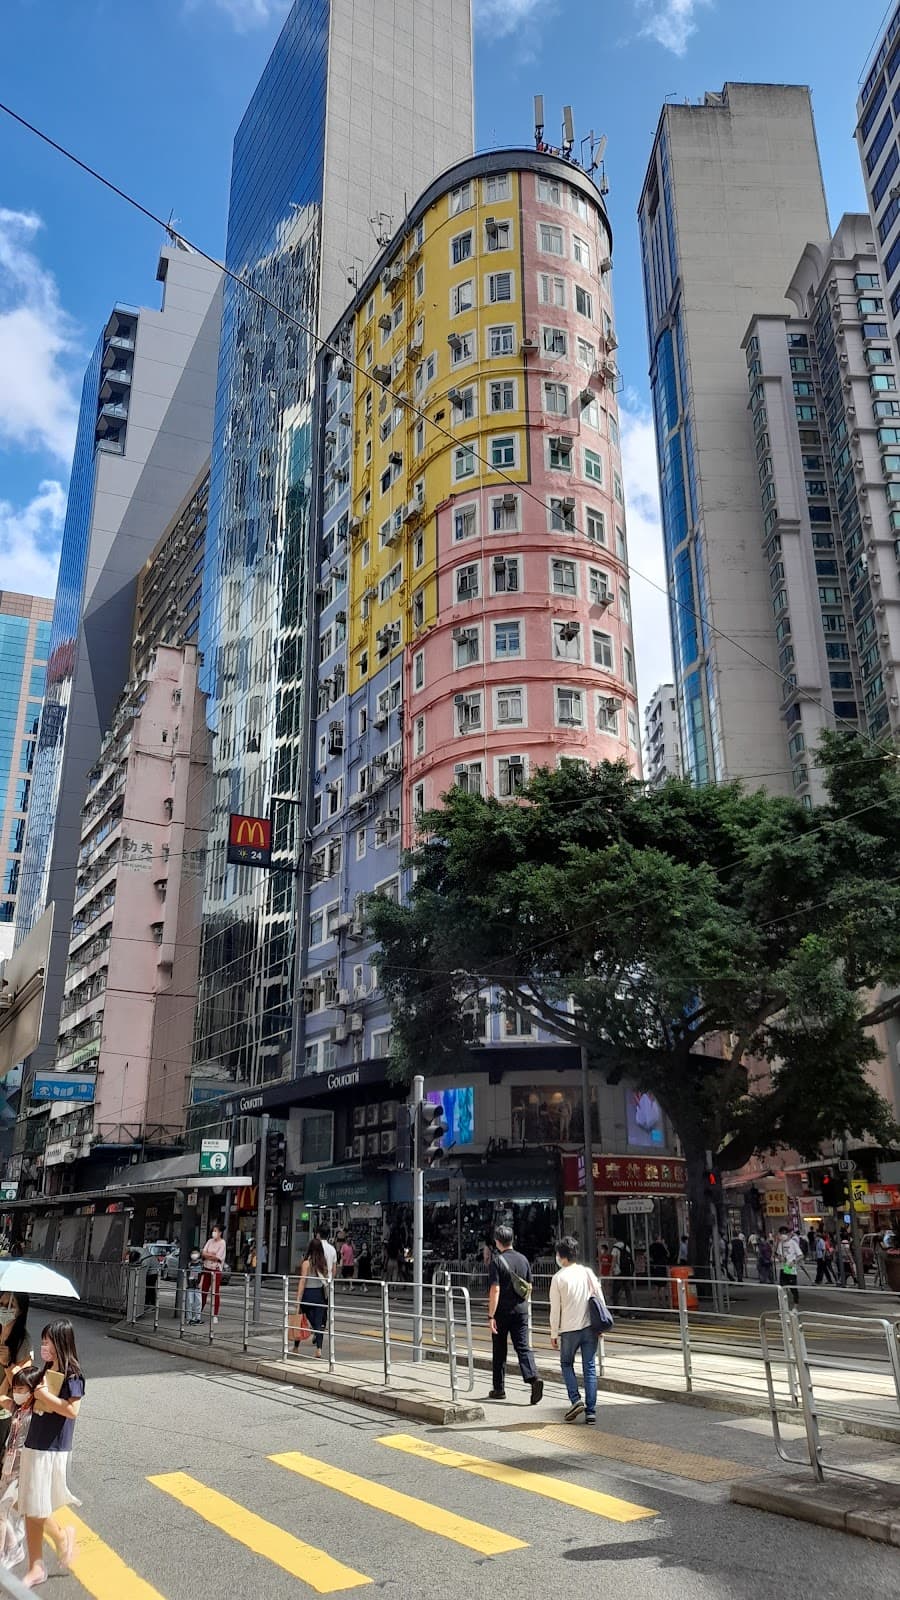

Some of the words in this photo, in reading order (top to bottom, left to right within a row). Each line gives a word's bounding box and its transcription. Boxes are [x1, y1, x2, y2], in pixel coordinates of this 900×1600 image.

[250, 850, 262, 861] 24
[327, 1068, 359, 1090] Gourami
[239, 1094, 263, 1111] Gourami
